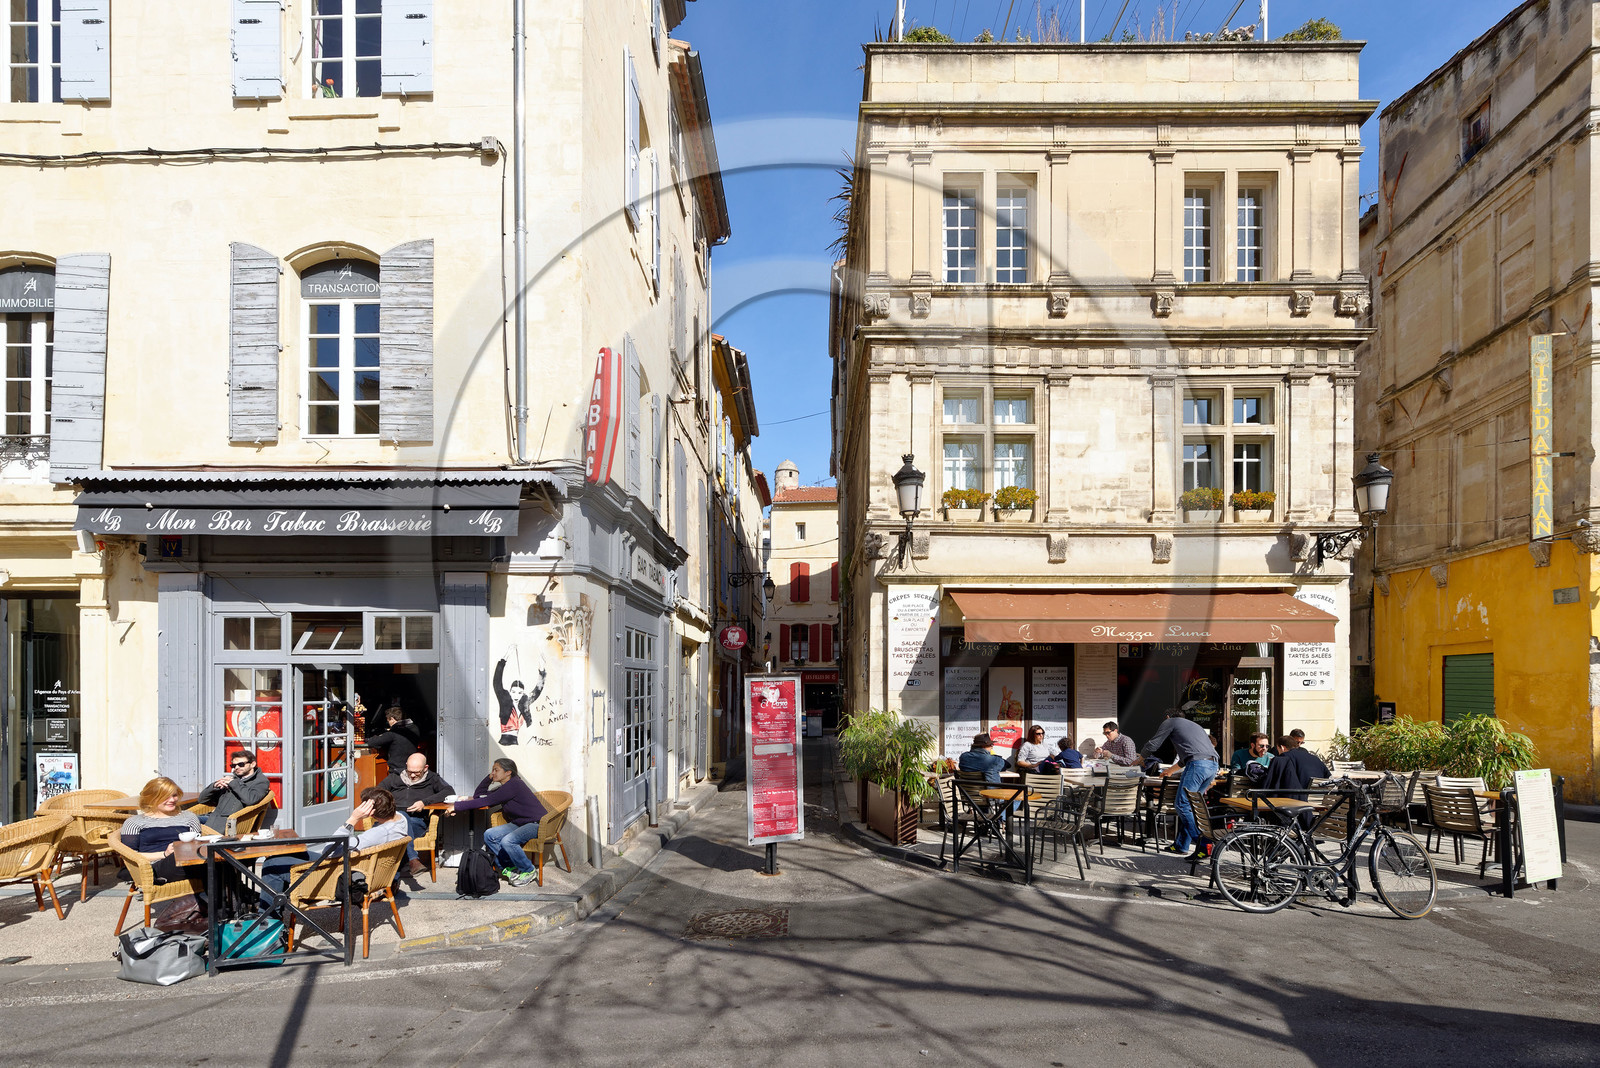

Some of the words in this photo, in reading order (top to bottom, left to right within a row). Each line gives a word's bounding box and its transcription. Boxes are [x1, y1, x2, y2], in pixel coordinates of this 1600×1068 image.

[585, 352, 605, 478] TABAC
[146, 508, 197, 531] Mon
[208, 509, 252, 531] Bar
[263, 510, 326, 531] Tabac
[336, 510, 432, 532] Brasserie
[1091, 624, 1154, 641] Mezza
[1164, 624, 1212, 637] Luna
[1231, 687, 1249, 695] Salon
[1250, 687, 1258, 695] de
[1237, 697, 1262, 707] Crêperi
